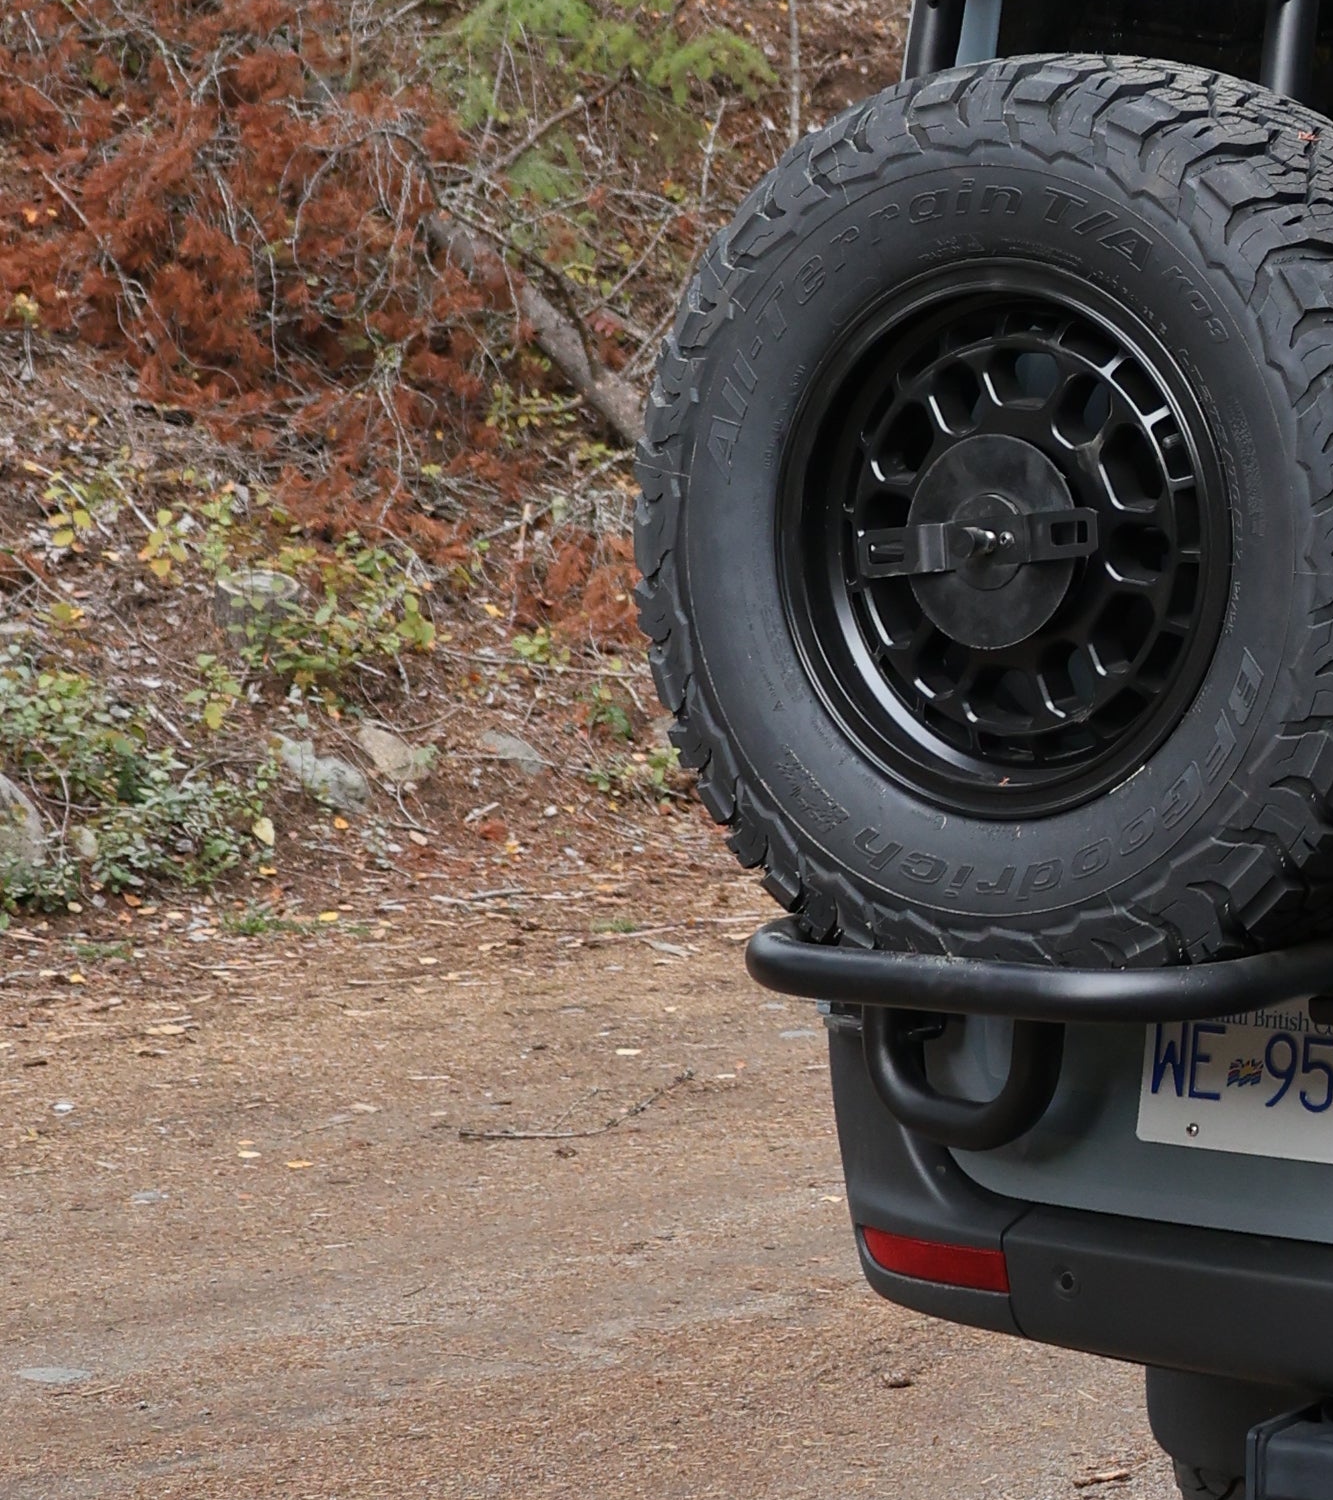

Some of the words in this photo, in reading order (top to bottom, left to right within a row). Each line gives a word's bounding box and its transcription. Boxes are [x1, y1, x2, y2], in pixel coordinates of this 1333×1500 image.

[705, 179, 1021, 483] All-Terrain
[1042, 186, 1160, 272] T/A
[853, 646, 1264, 901] BFGoodrich
[1151, 1021, 1226, 1100] WE
[1254, 1009, 1309, 1034] British
